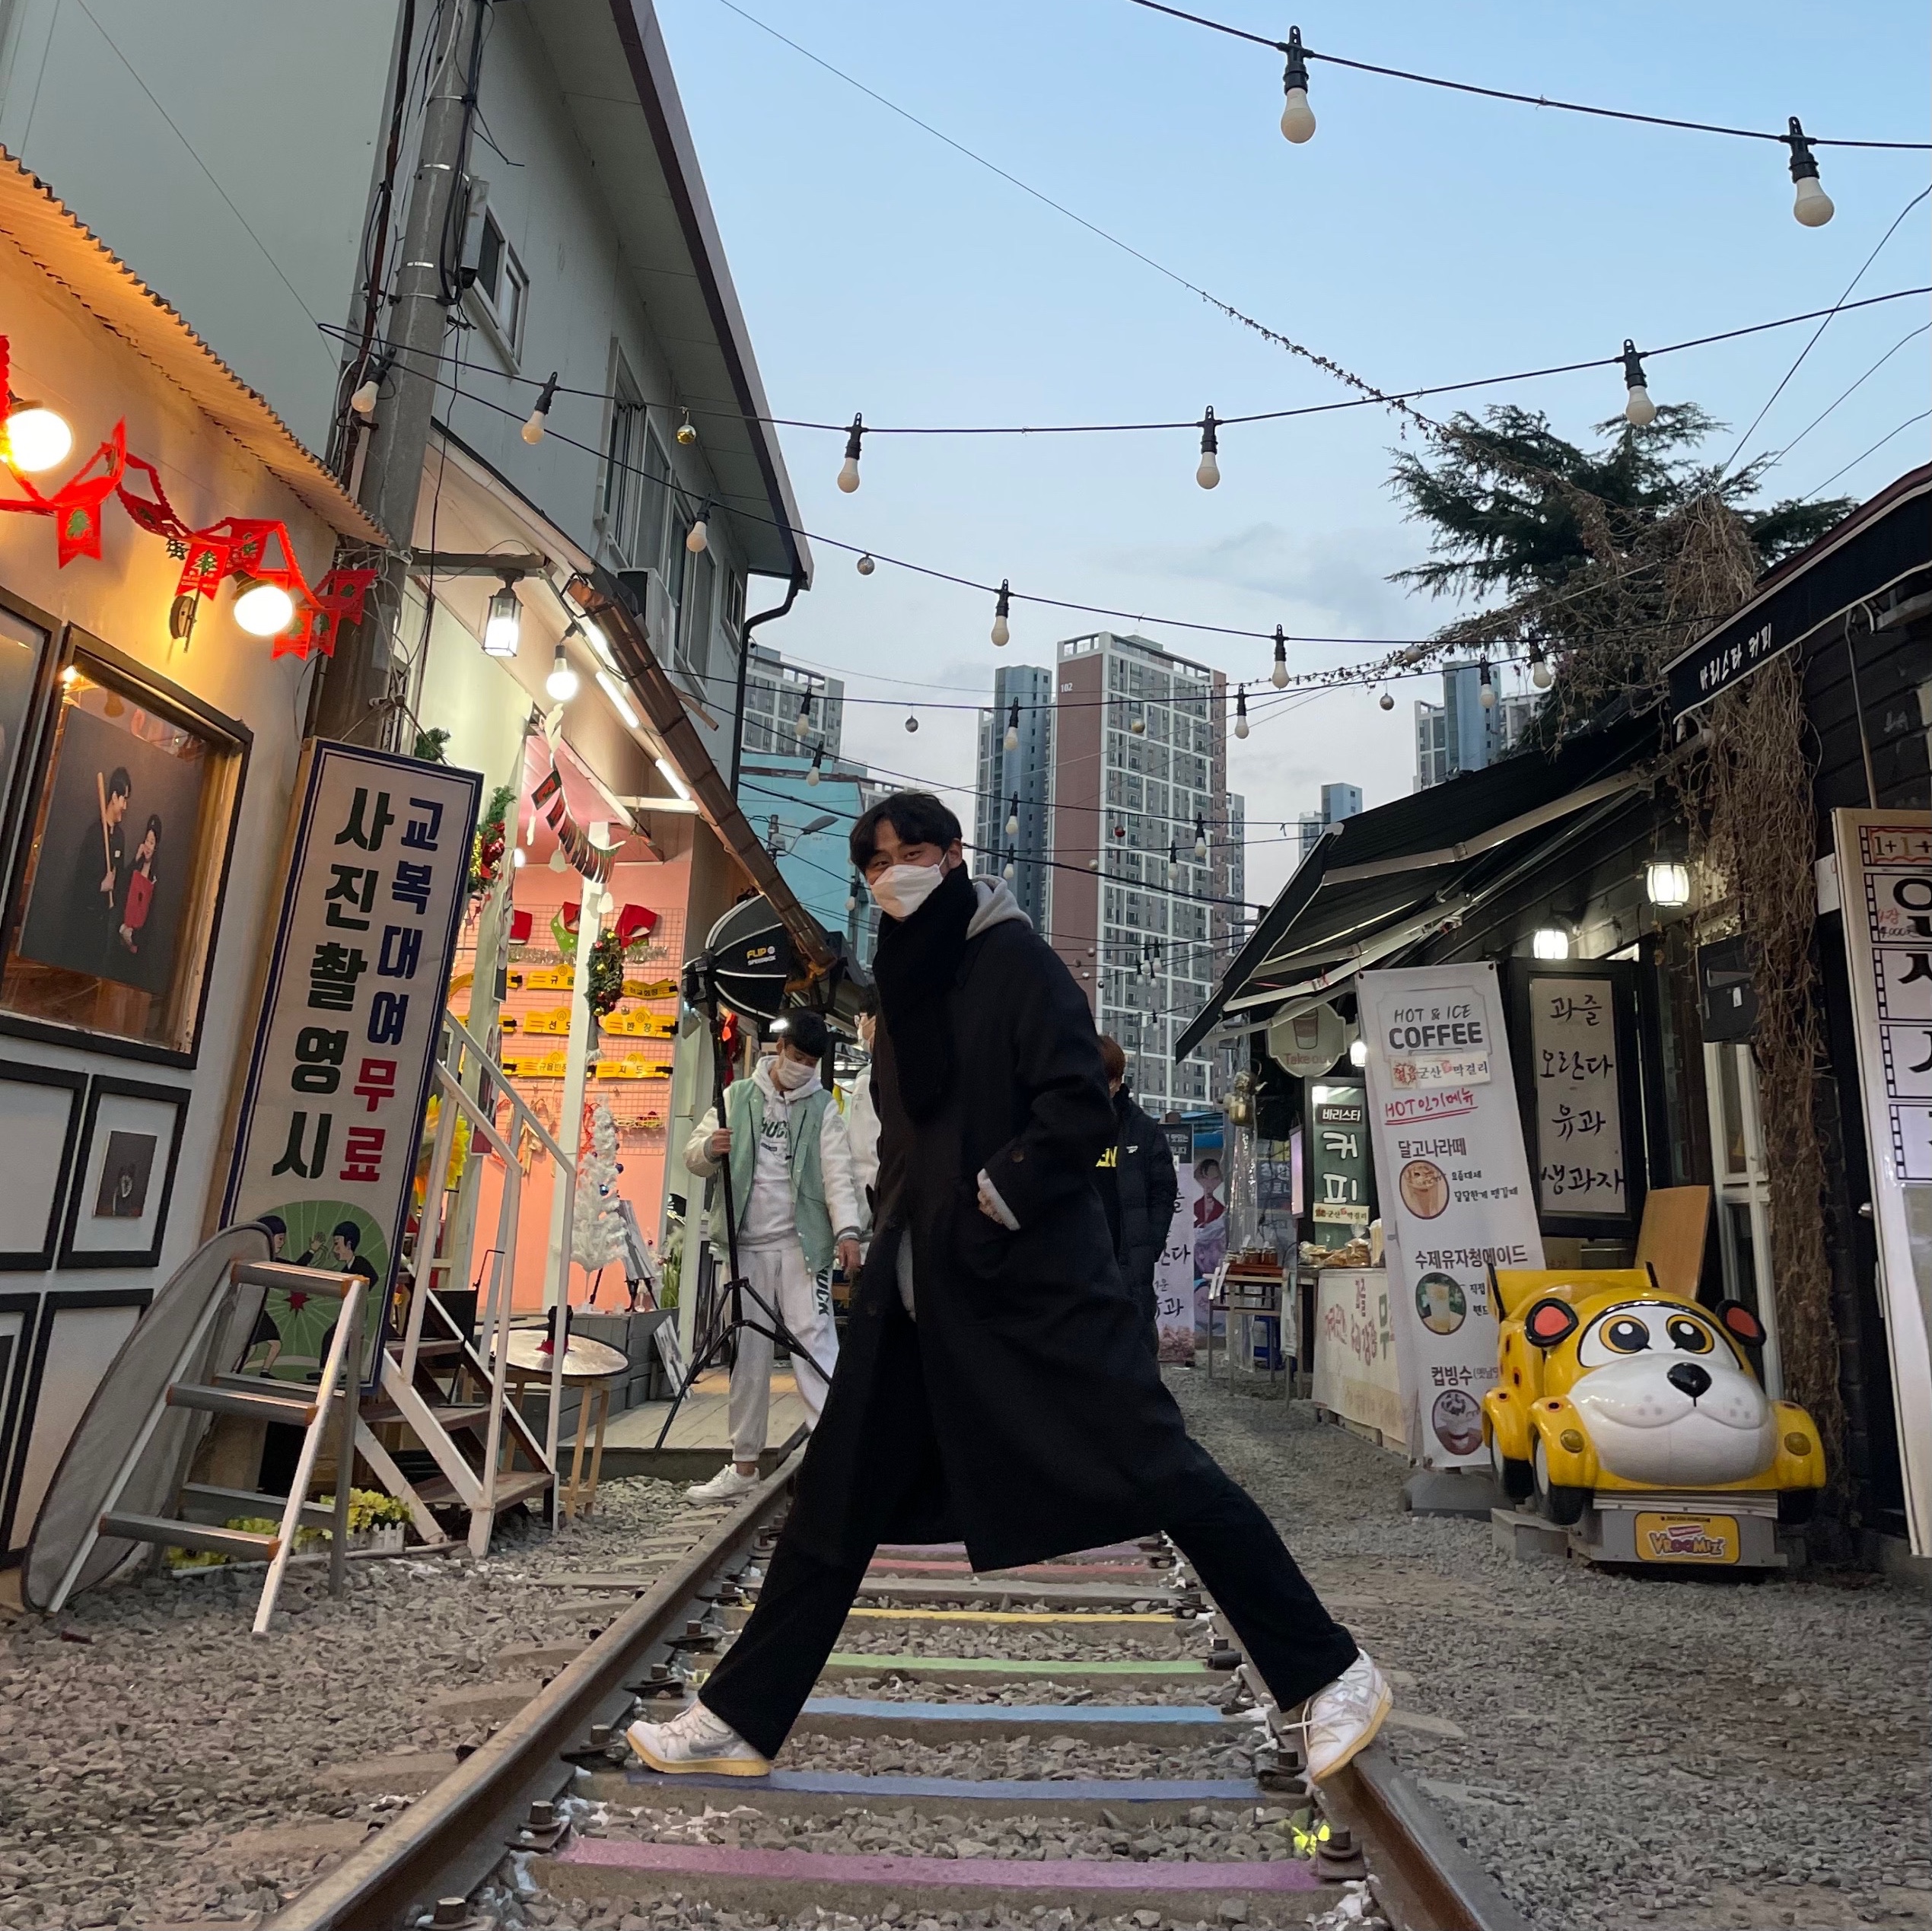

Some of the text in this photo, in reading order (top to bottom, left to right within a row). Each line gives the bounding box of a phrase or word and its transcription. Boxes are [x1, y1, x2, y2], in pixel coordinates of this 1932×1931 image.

[1700, 643, 1743, 691] 바리스타
[1060, 682, 1073, 692] 102
[746, 947, 767, 959] FLIP
[1394, 1004, 1472, 1023] HOT & ICE
[1550, 994, 1602, 1026] 과즐
[1389, 1022, 1483, 1049] COFFEE
[1284, 1053, 1308, 1065] Take
[1453, 1061, 1488, 1077] 막걸리
[1540, 1049, 1613, 1080] 오란다
[1322, 1109, 1361, 1121] 바리스타
[1552, 1104, 1606, 1141] 유과
[1399, 1137, 1466, 1158] 달고나라떼
[1322, 1131, 1358, 1204] 커피
[1540, 1164, 1625, 1195] 생과자
